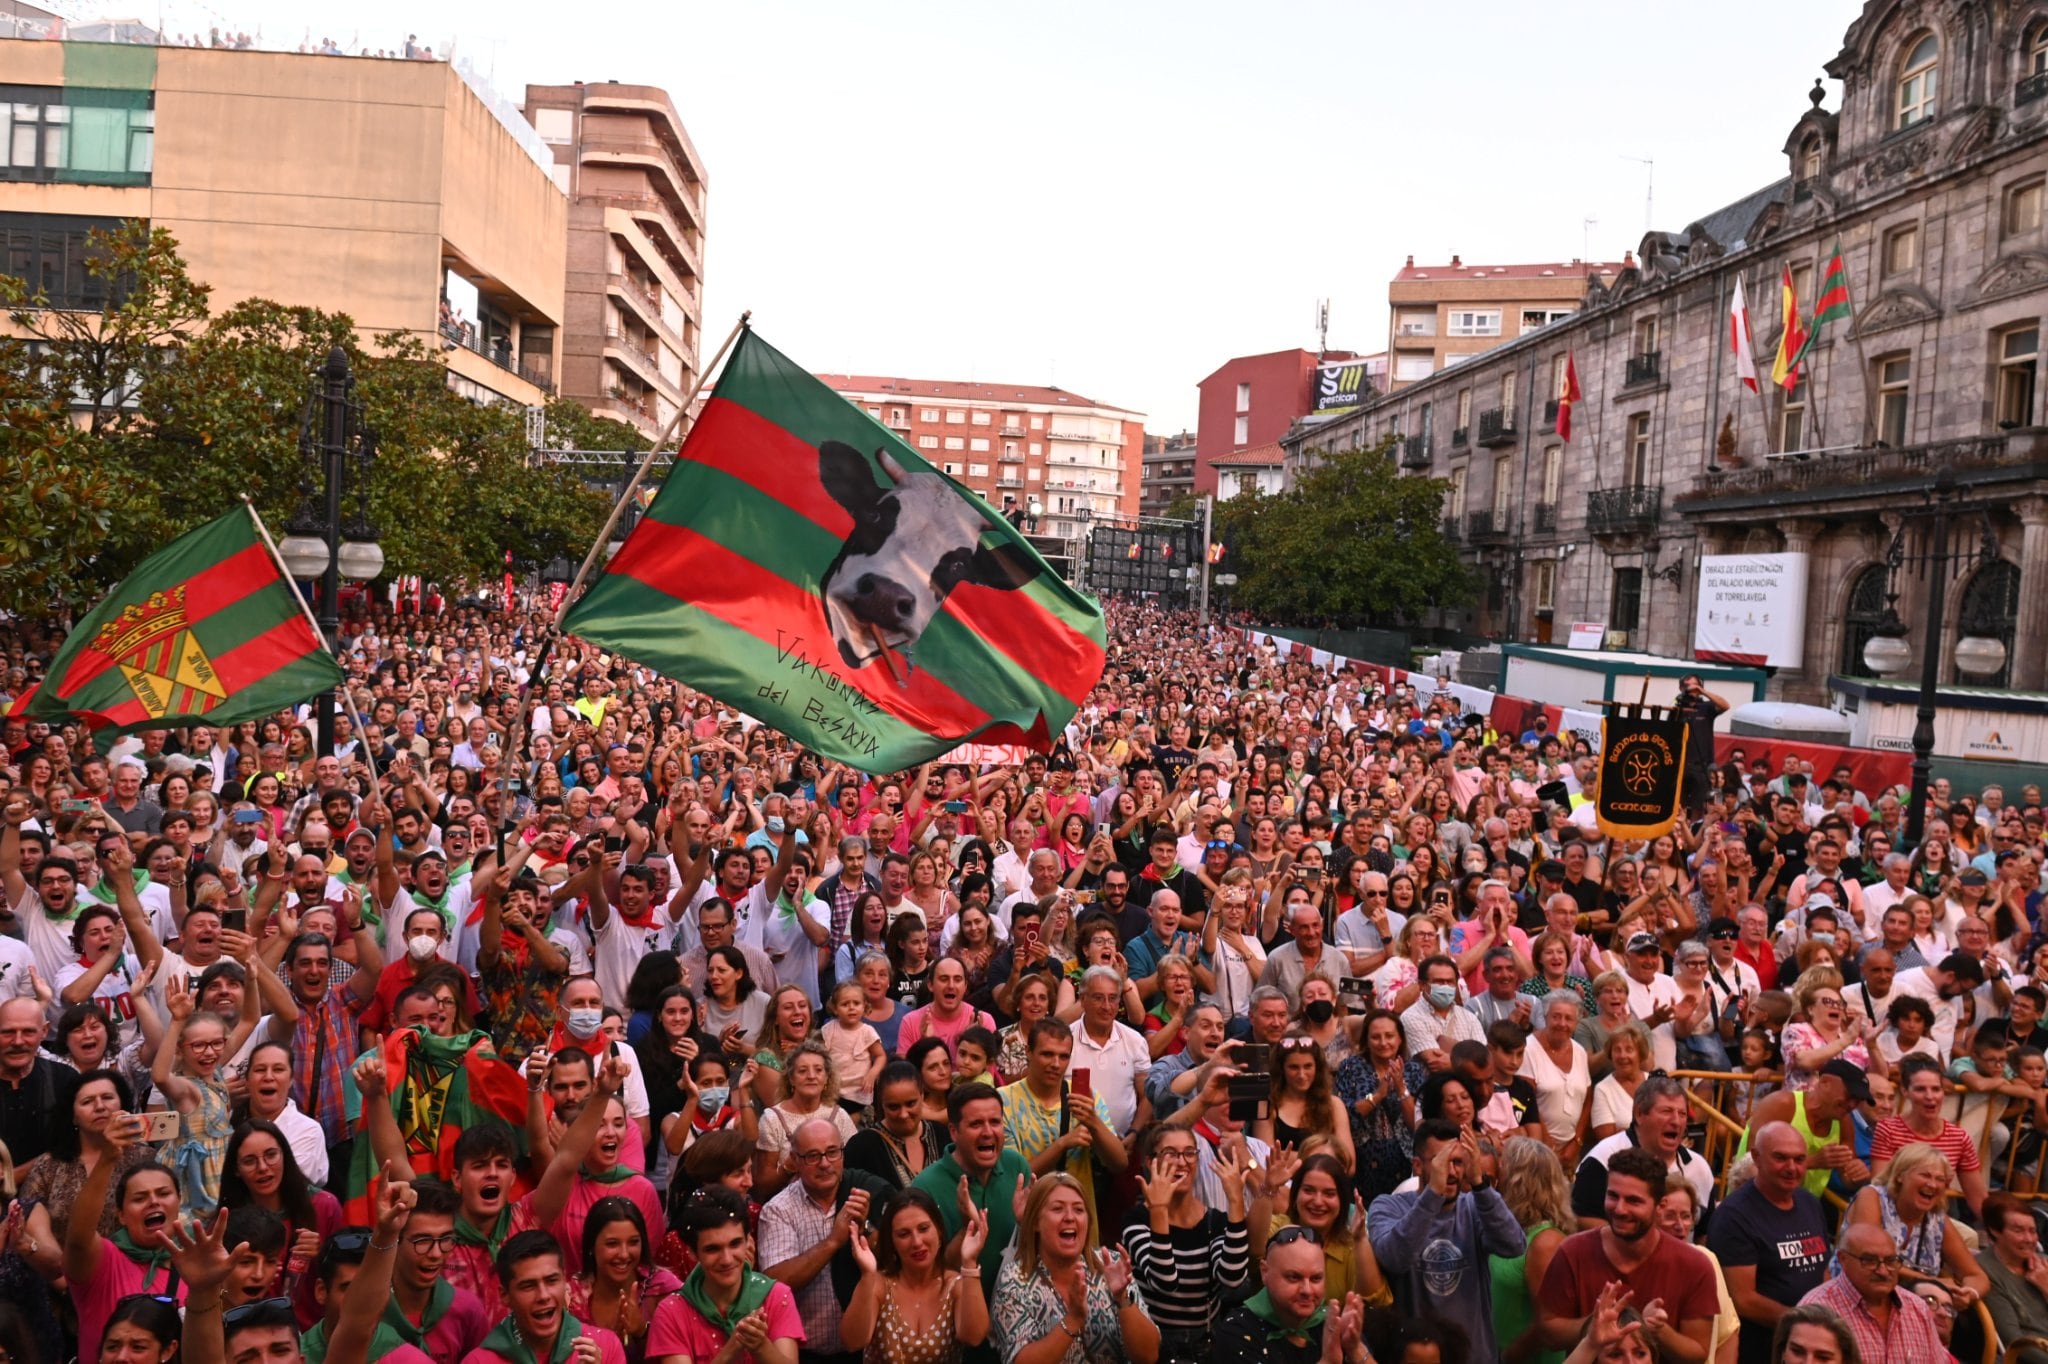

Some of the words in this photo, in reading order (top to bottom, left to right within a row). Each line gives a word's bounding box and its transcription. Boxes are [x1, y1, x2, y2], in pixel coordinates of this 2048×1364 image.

[1319, 393, 1358, 410] gestican
[1705, 565, 1725, 574] OBRAS
[1726, 565, 1734, 574] DE
[1707, 579, 1718, 588] DEL
[1719, 579, 1744, 588] PALACIO
[1745, 579, 1778, 588] MUNICIPAL
[1715, 592, 1724, 601] DE
[1725, 592, 1767, 601] TORRELAVEGA
[1788, 1253, 1825, 1268] JEANS
